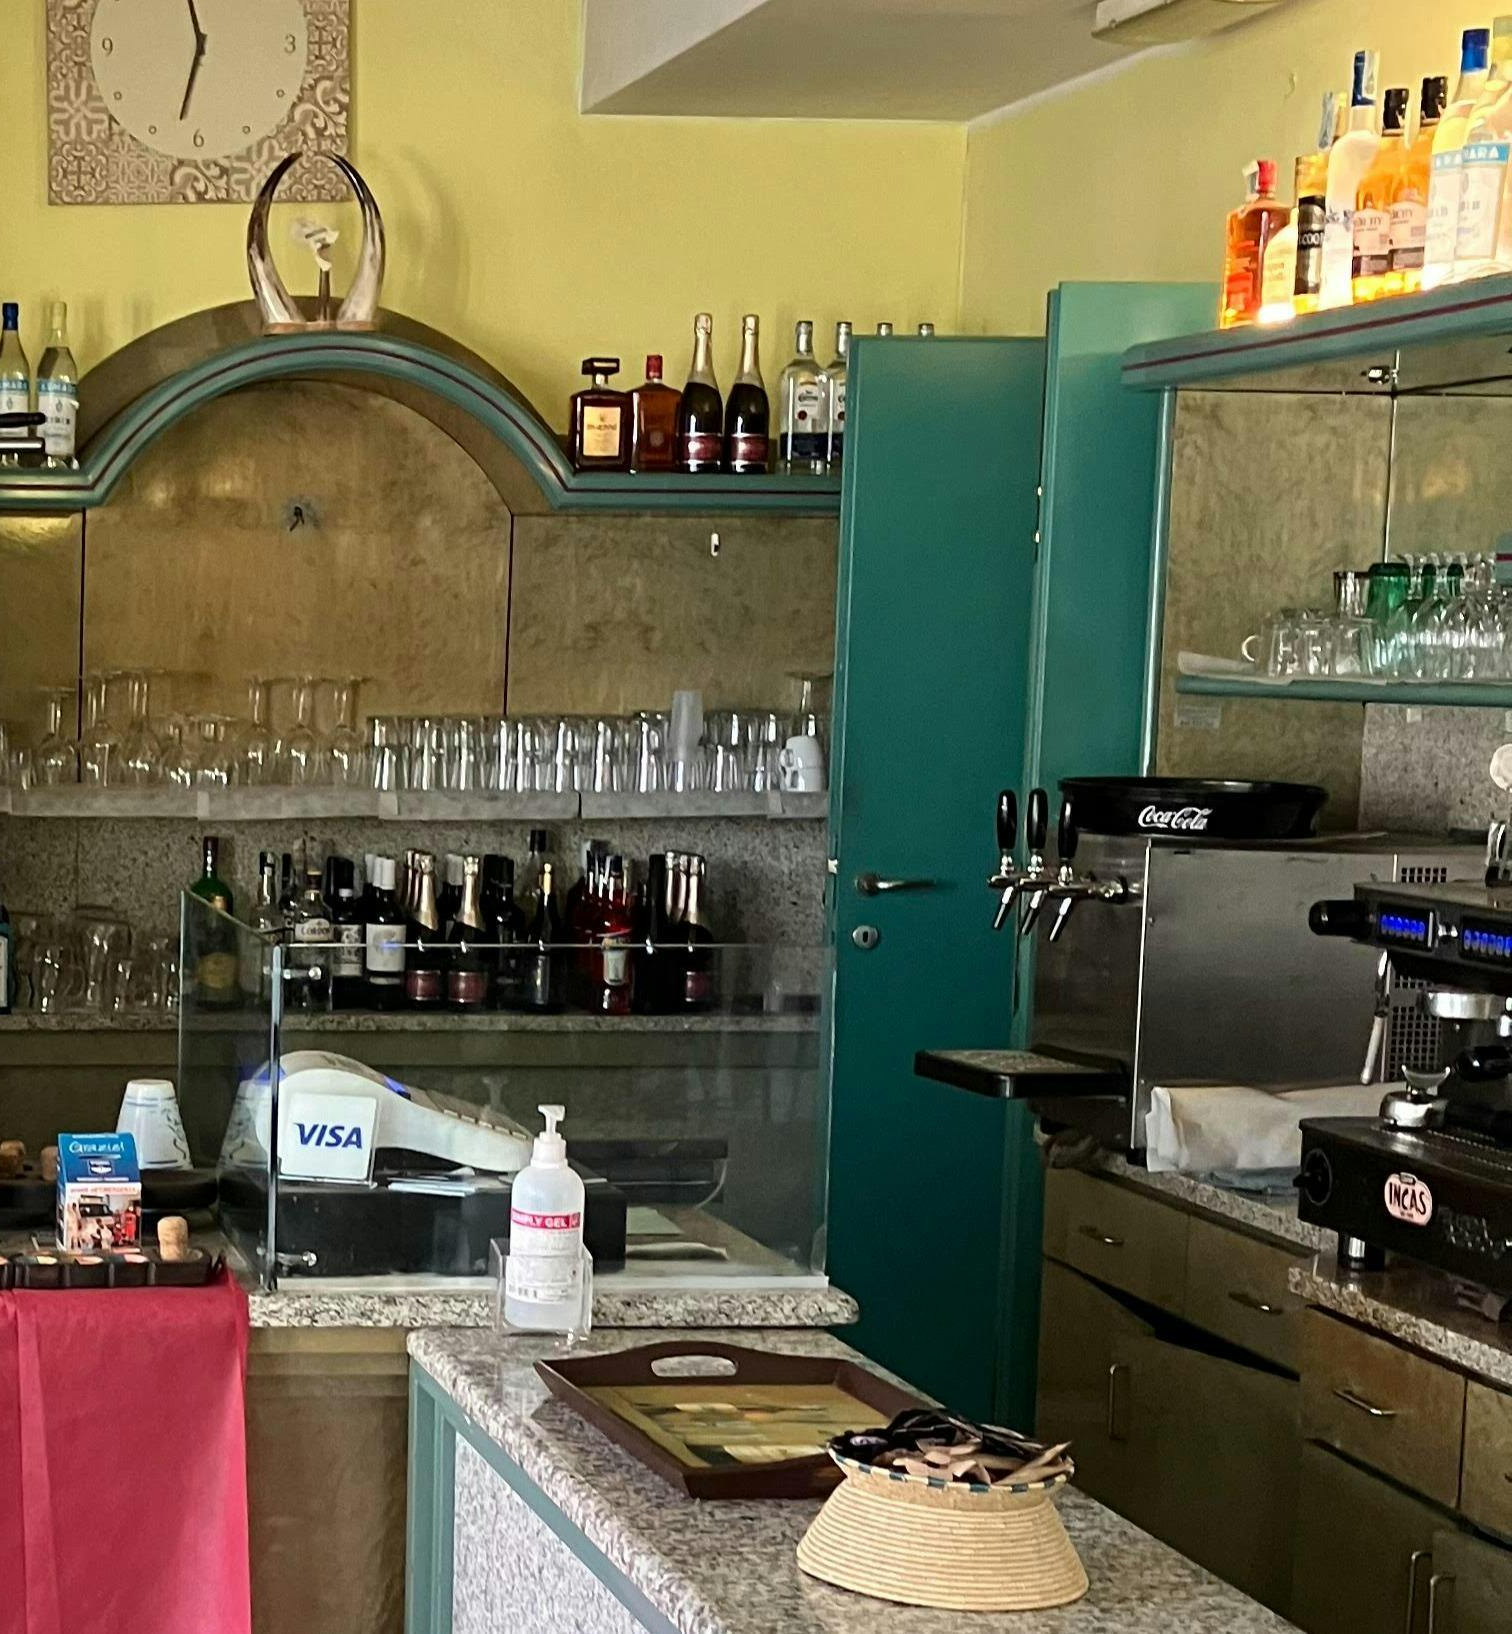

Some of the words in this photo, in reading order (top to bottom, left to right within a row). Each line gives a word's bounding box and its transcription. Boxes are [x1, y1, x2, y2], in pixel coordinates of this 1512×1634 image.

[100, 37, 114, 57] 9
[283, 34, 297, 55] 3
[192, 128, 205, 148] 6
[1137, 804, 1214, 831] Coca-Cola
[292, 1122, 363, 1150] VISA
[1388, 1181, 1427, 1216] INCAS
[544, 1217, 568, 1228] GEL
